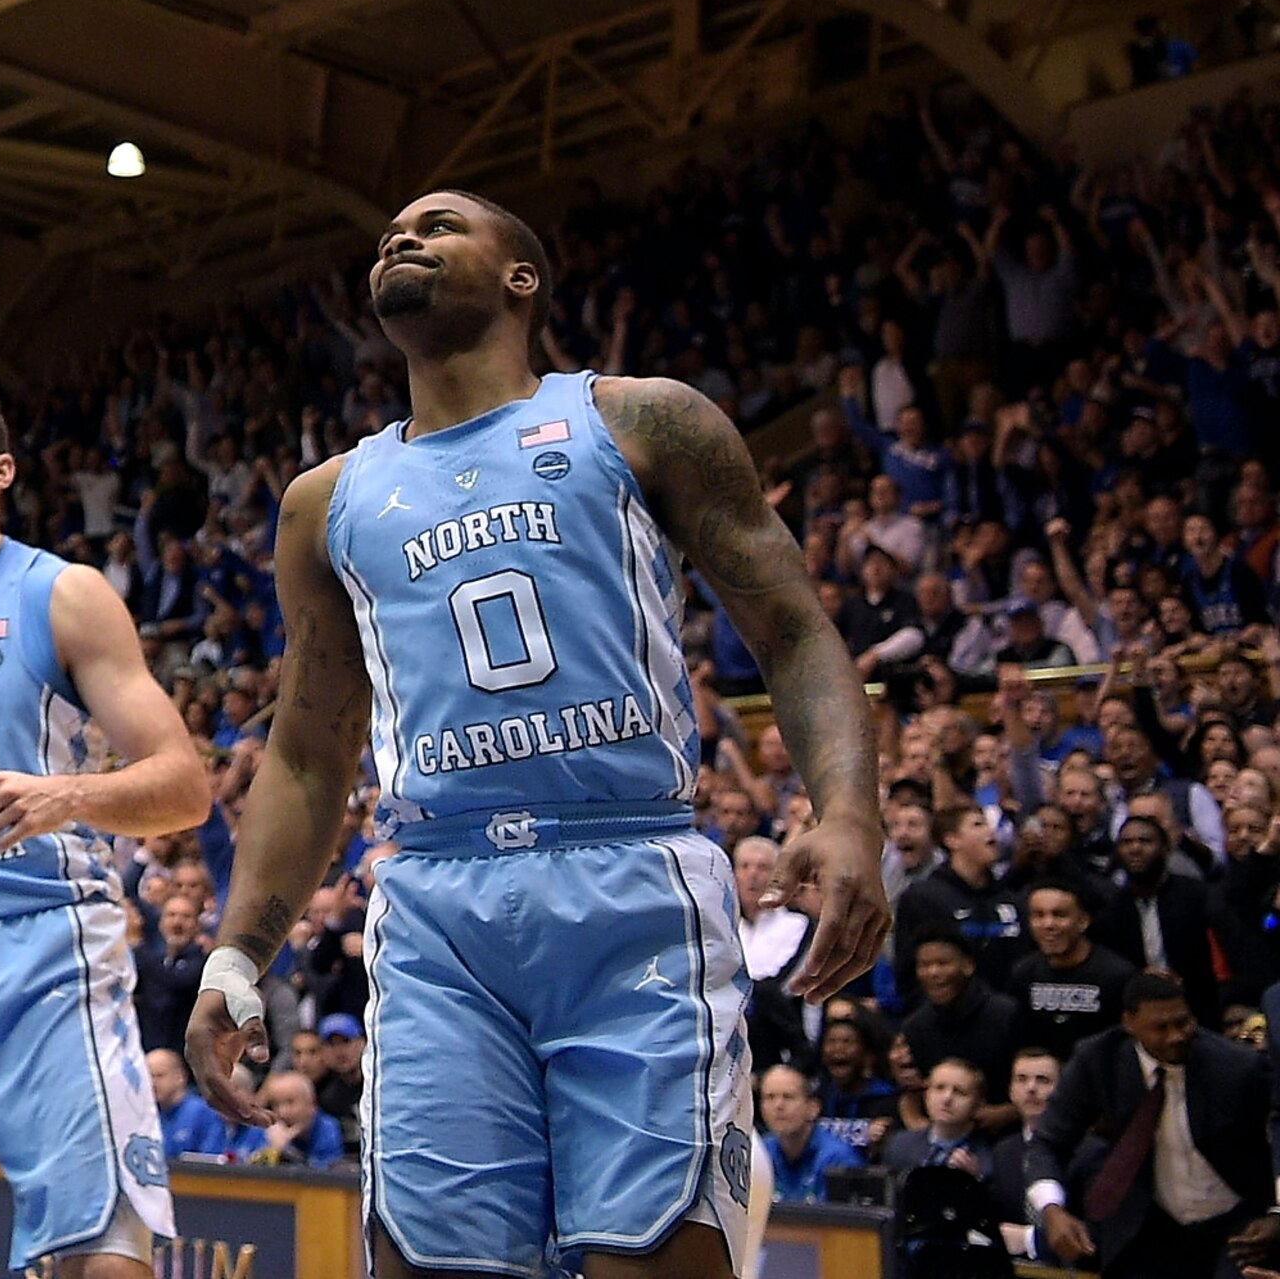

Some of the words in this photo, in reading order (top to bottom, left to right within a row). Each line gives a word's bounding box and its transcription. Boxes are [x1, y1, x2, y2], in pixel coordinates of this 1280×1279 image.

[402, 500, 562, 583] NORTH
[448, 568, 559, 694] 0
[415, 694, 652, 776] CAROLINA
